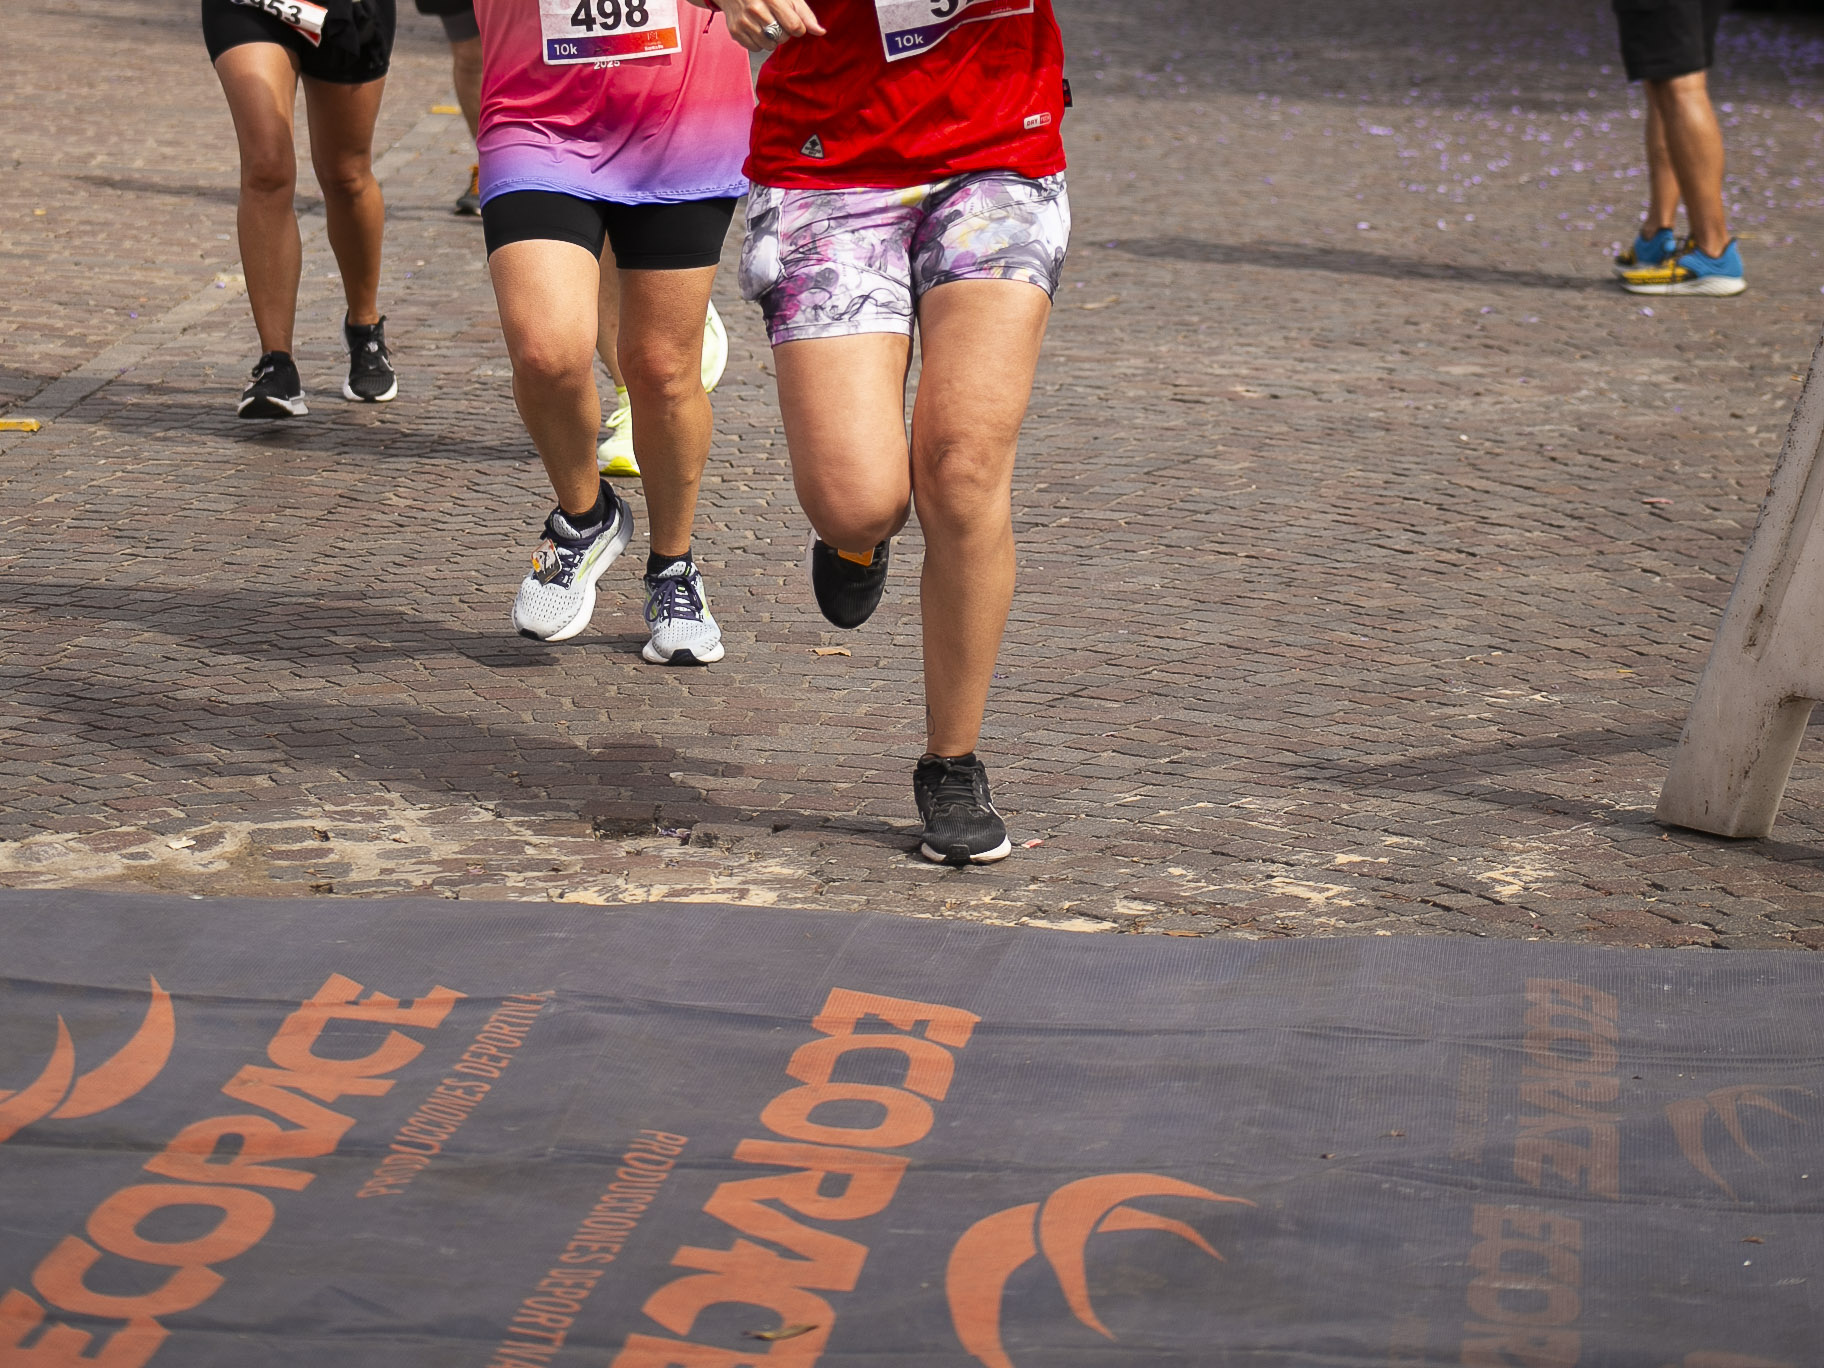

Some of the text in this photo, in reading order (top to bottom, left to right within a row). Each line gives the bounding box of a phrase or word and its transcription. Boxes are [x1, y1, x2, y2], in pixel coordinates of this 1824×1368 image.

[554, 43, 578, 56] 10k
[593, 60, 621, 70] 2025
[895, 33, 924, 48] 10k
[0, 973, 468, 1368] ECORACE
[355, 1078, 492, 1199] PRODUCCIONES
[558, 1128, 689, 1264] PRODUCCIONES
[1460, 1203, 1584, 1368] ECOR
